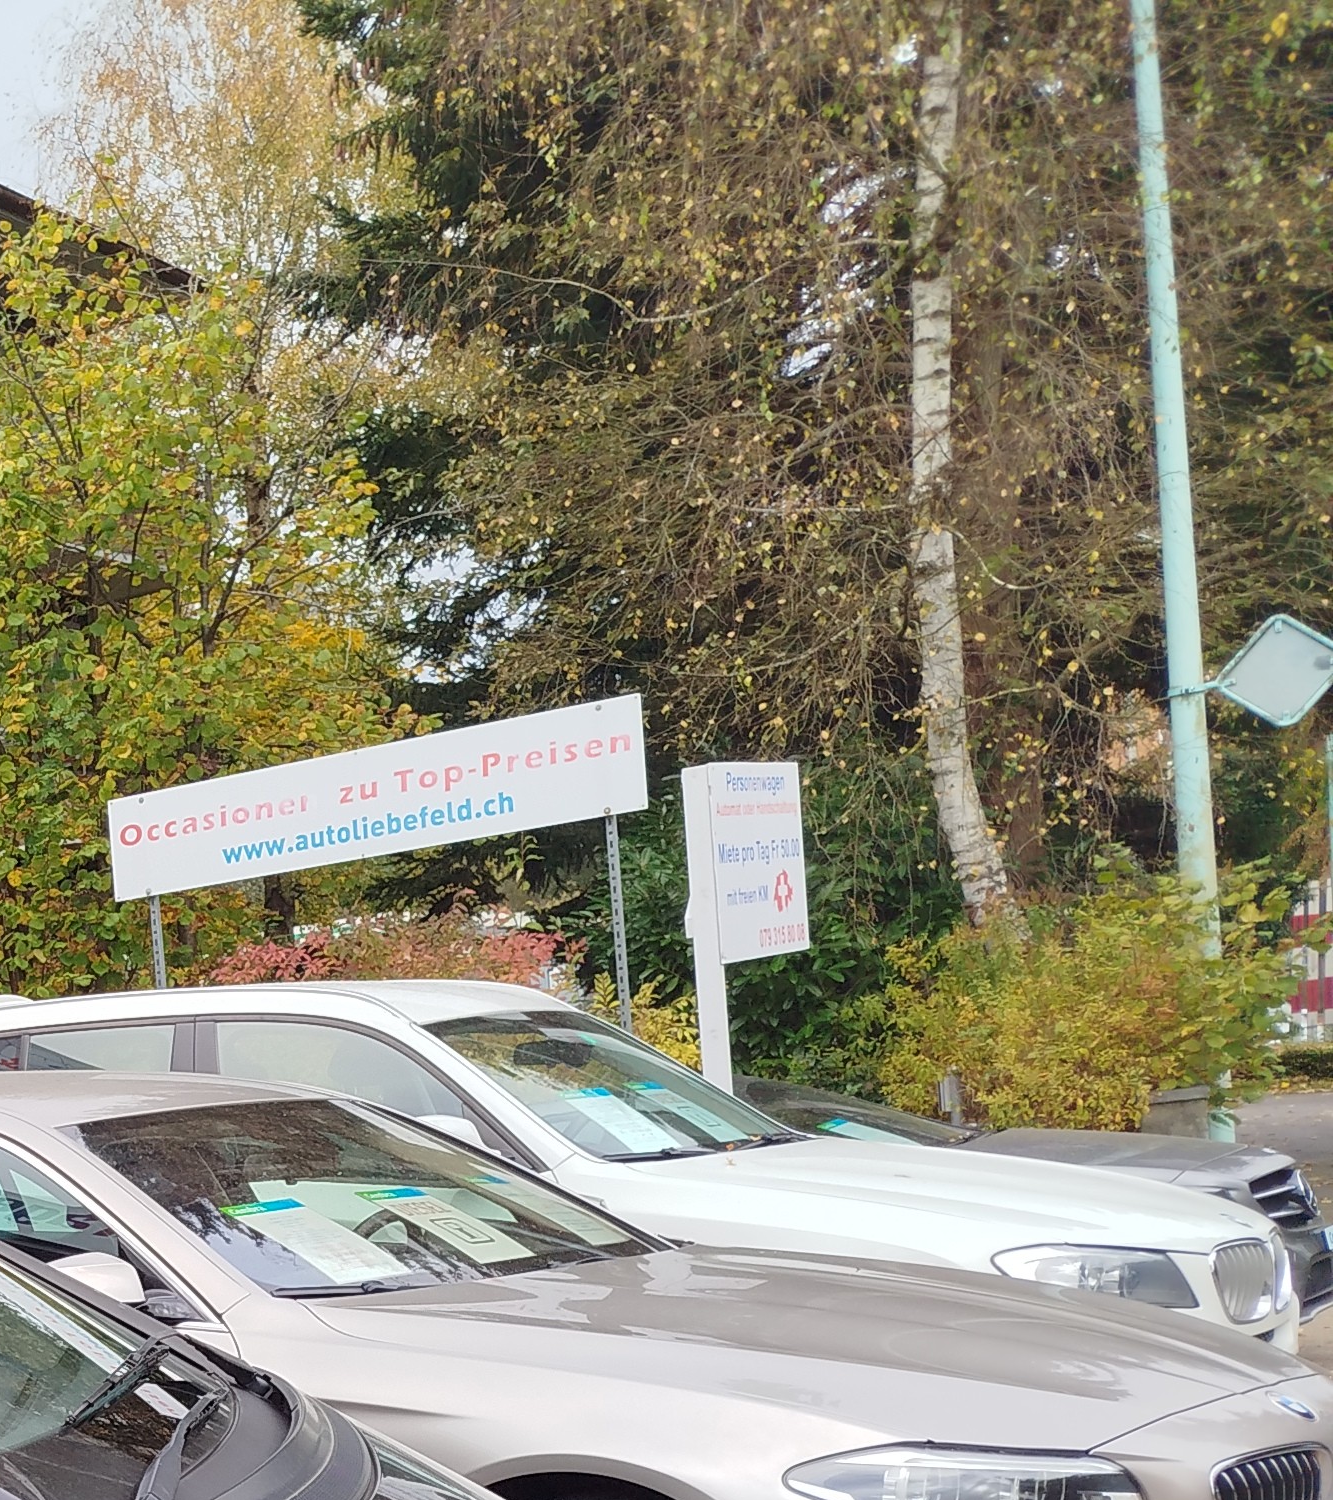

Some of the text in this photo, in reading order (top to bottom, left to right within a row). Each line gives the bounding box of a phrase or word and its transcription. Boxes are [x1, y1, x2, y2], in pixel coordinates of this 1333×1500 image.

[339, 780, 378, 805] zu
[393, 733, 632, 792] Top-Preisen
[221, 791, 515, 864] www.autoliebefeld.ch
[718, 843, 740, 863] Miete
[742, 846, 754, 868] pro
[756, 840, 770, 865] Tag
